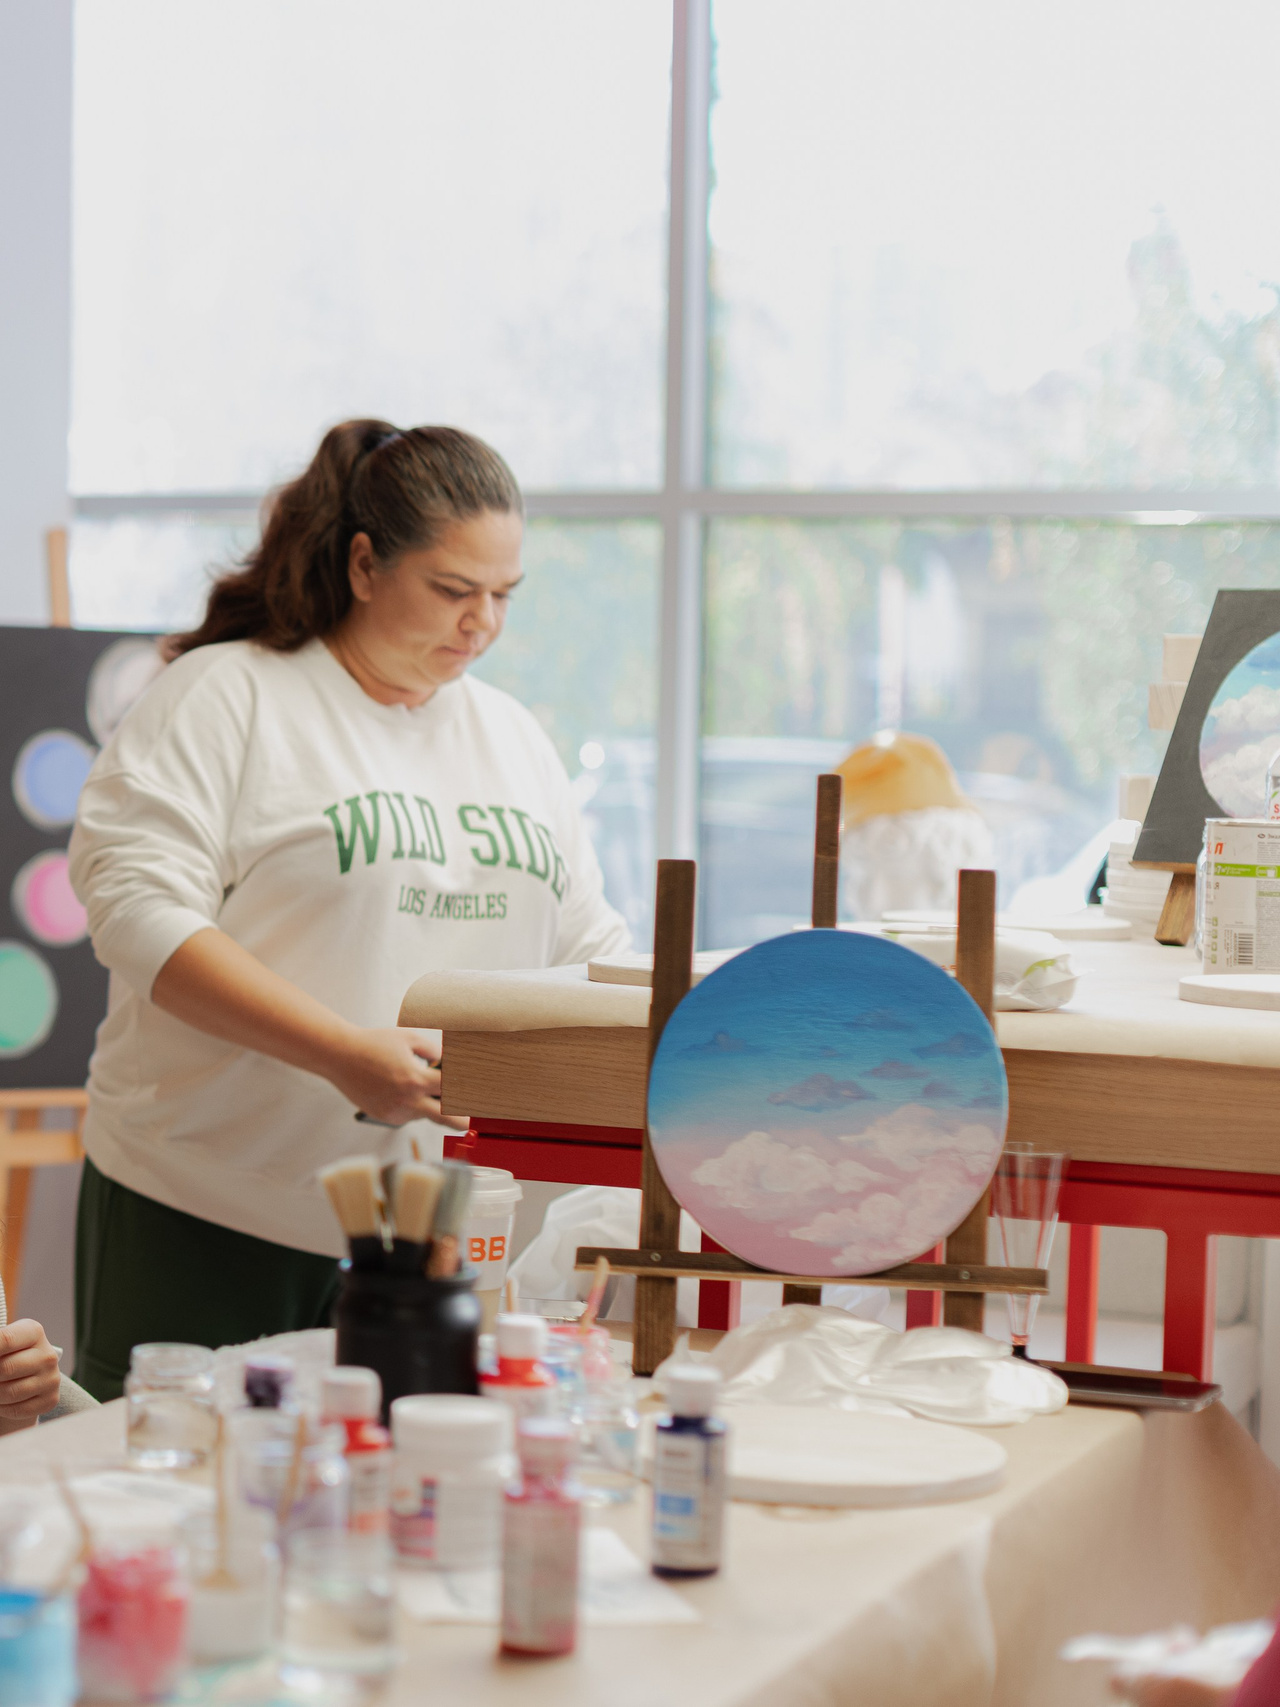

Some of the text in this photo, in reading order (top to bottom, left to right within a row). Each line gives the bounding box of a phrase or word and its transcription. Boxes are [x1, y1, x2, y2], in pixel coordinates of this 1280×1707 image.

[323, 790, 569, 904] WILD SIDE
[398, 884, 508, 920] LOS ANGELES
[468, 1236, 506, 1262] BB
